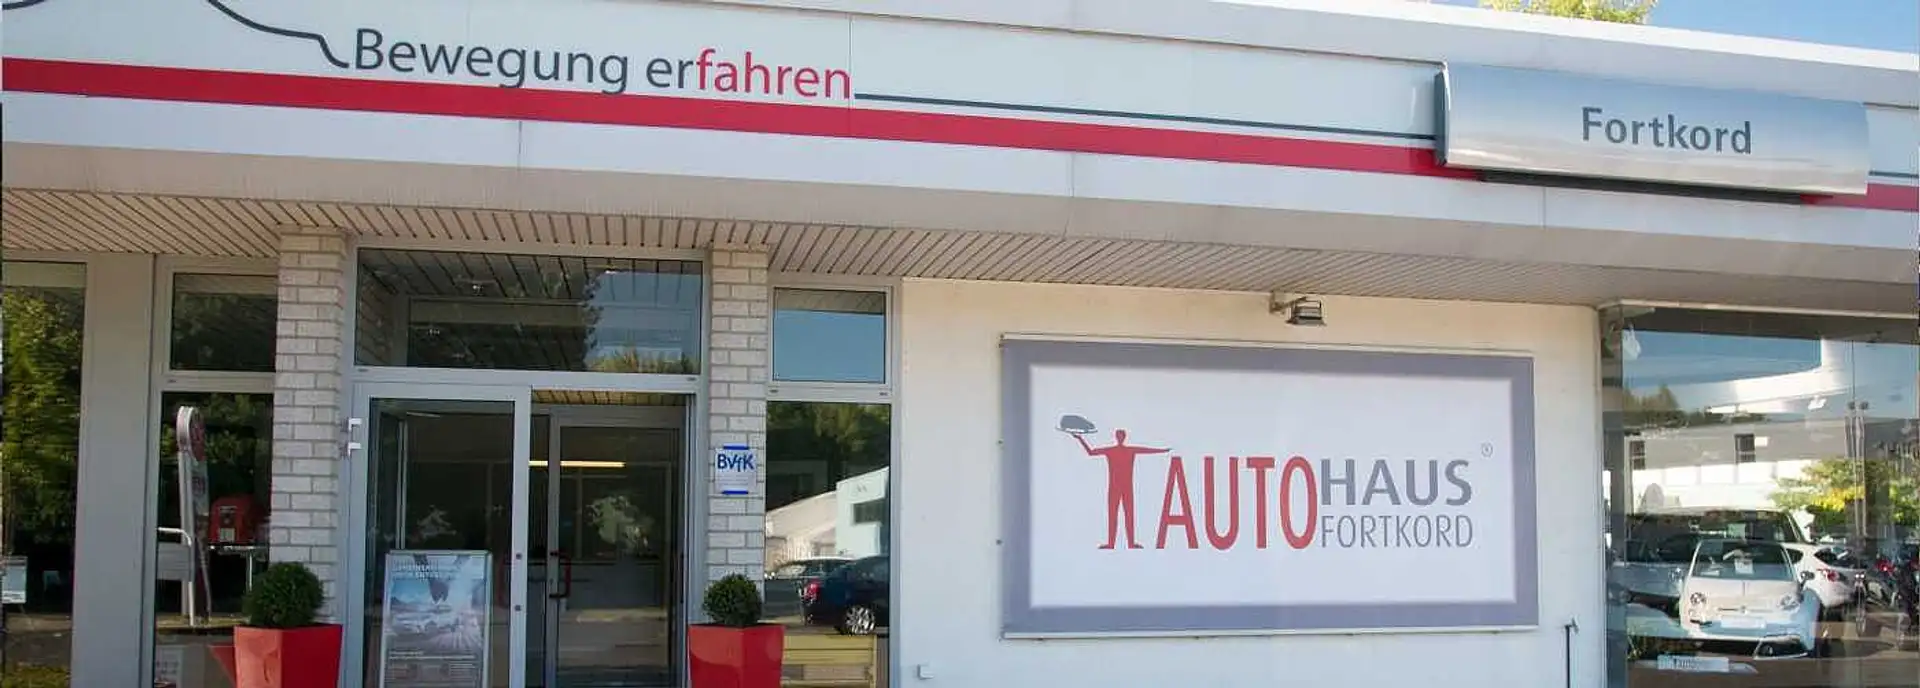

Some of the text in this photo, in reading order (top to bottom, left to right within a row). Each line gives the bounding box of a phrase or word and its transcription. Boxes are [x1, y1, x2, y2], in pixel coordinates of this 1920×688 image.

[355, 28, 851, 99] Bewegung erfahren
[1582, 106, 1751, 154] Fortkord
[717, 453, 754, 472] BVfK
[1321, 515, 1473, 548] FORTKORD
